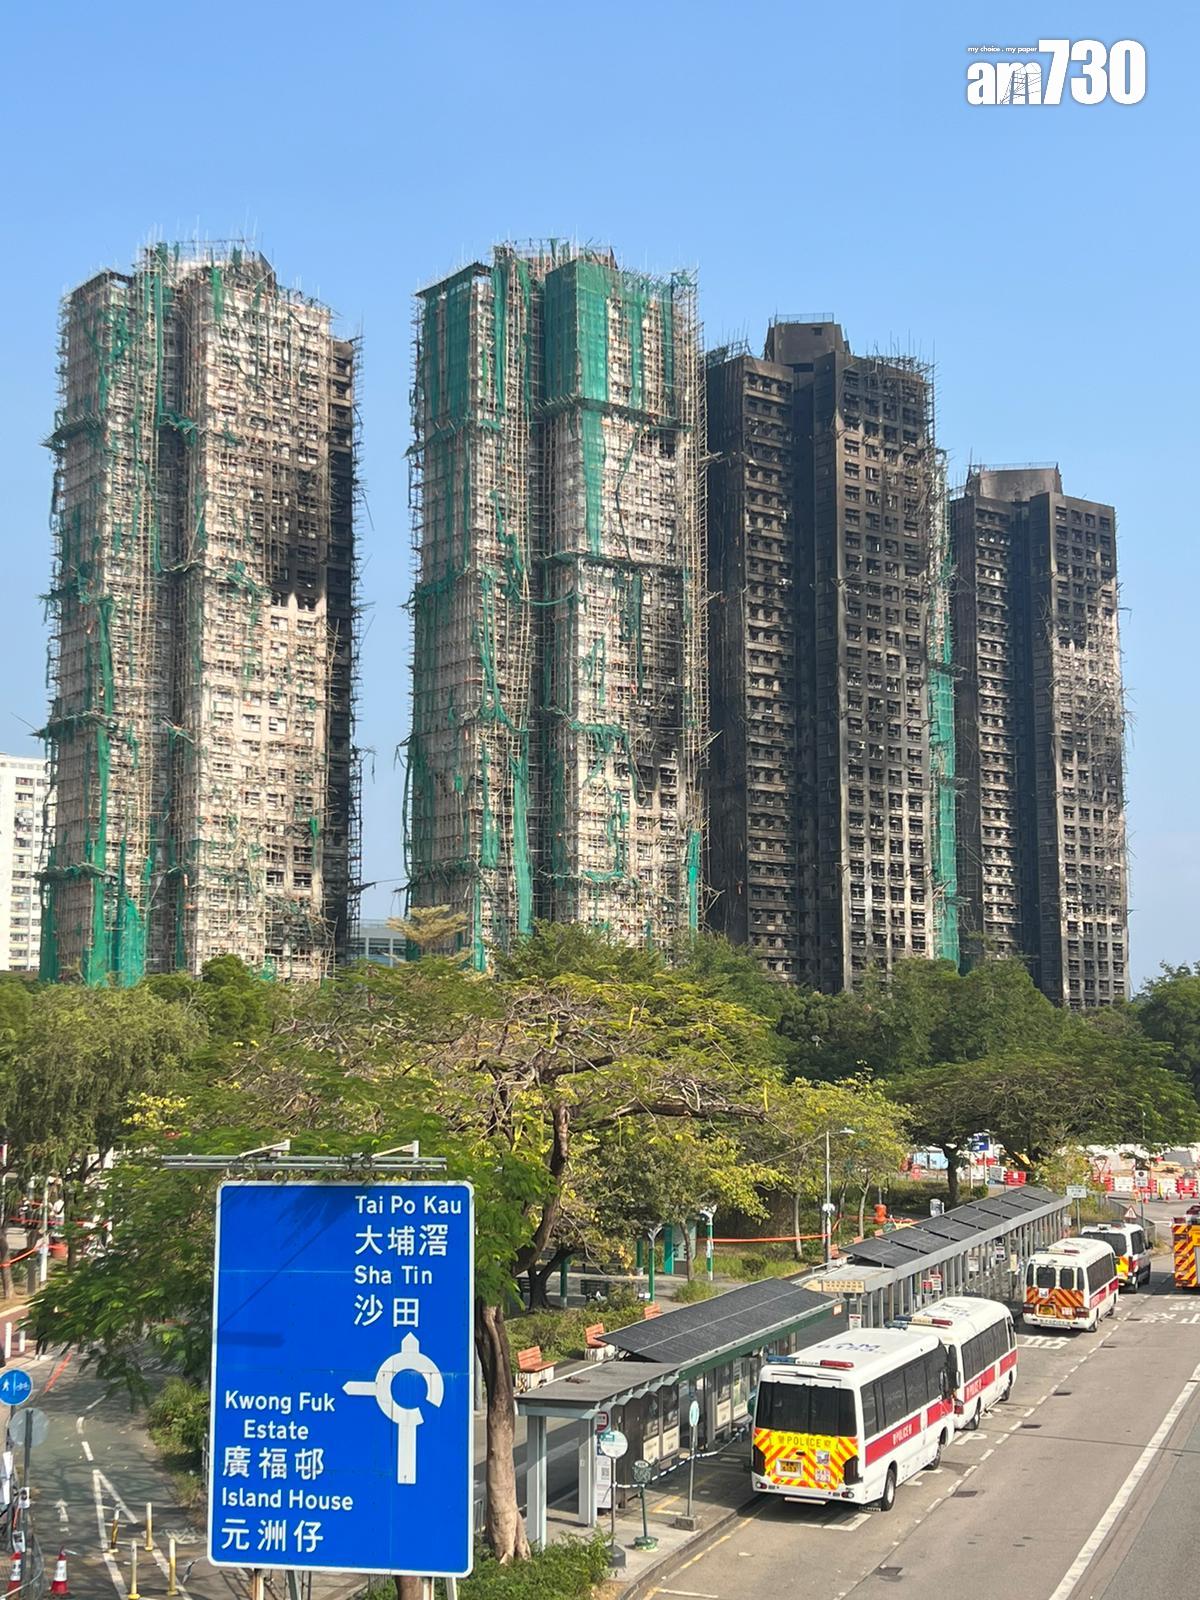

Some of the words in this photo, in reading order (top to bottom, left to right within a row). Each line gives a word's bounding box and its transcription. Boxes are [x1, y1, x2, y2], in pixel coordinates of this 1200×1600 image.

[355, 1195, 384, 1214] Tai
[391, 1195, 416, 1215] Po
[424, 1195, 462, 1214] Kau
[355, 1224, 449, 1257] 大埔滘
[354, 1265, 392, 1285] Sha
[401, 1265, 433, 1284] Tin
[354, 1294, 420, 1328] 沙田
[225, 1390, 292, 1415] Kwong
[299, 1391, 336, 1412] Fuk
[244, 1419, 309, 1440] Estate
[786, 1435, 821, 1448] POLICE
[222, 1445, 325, 1481] 廣福邨
[222, 1487, 282, 1508] Island
[289, 1489, 354, 1511] House
[221, 1518, 324, 1553] 元洲仔
